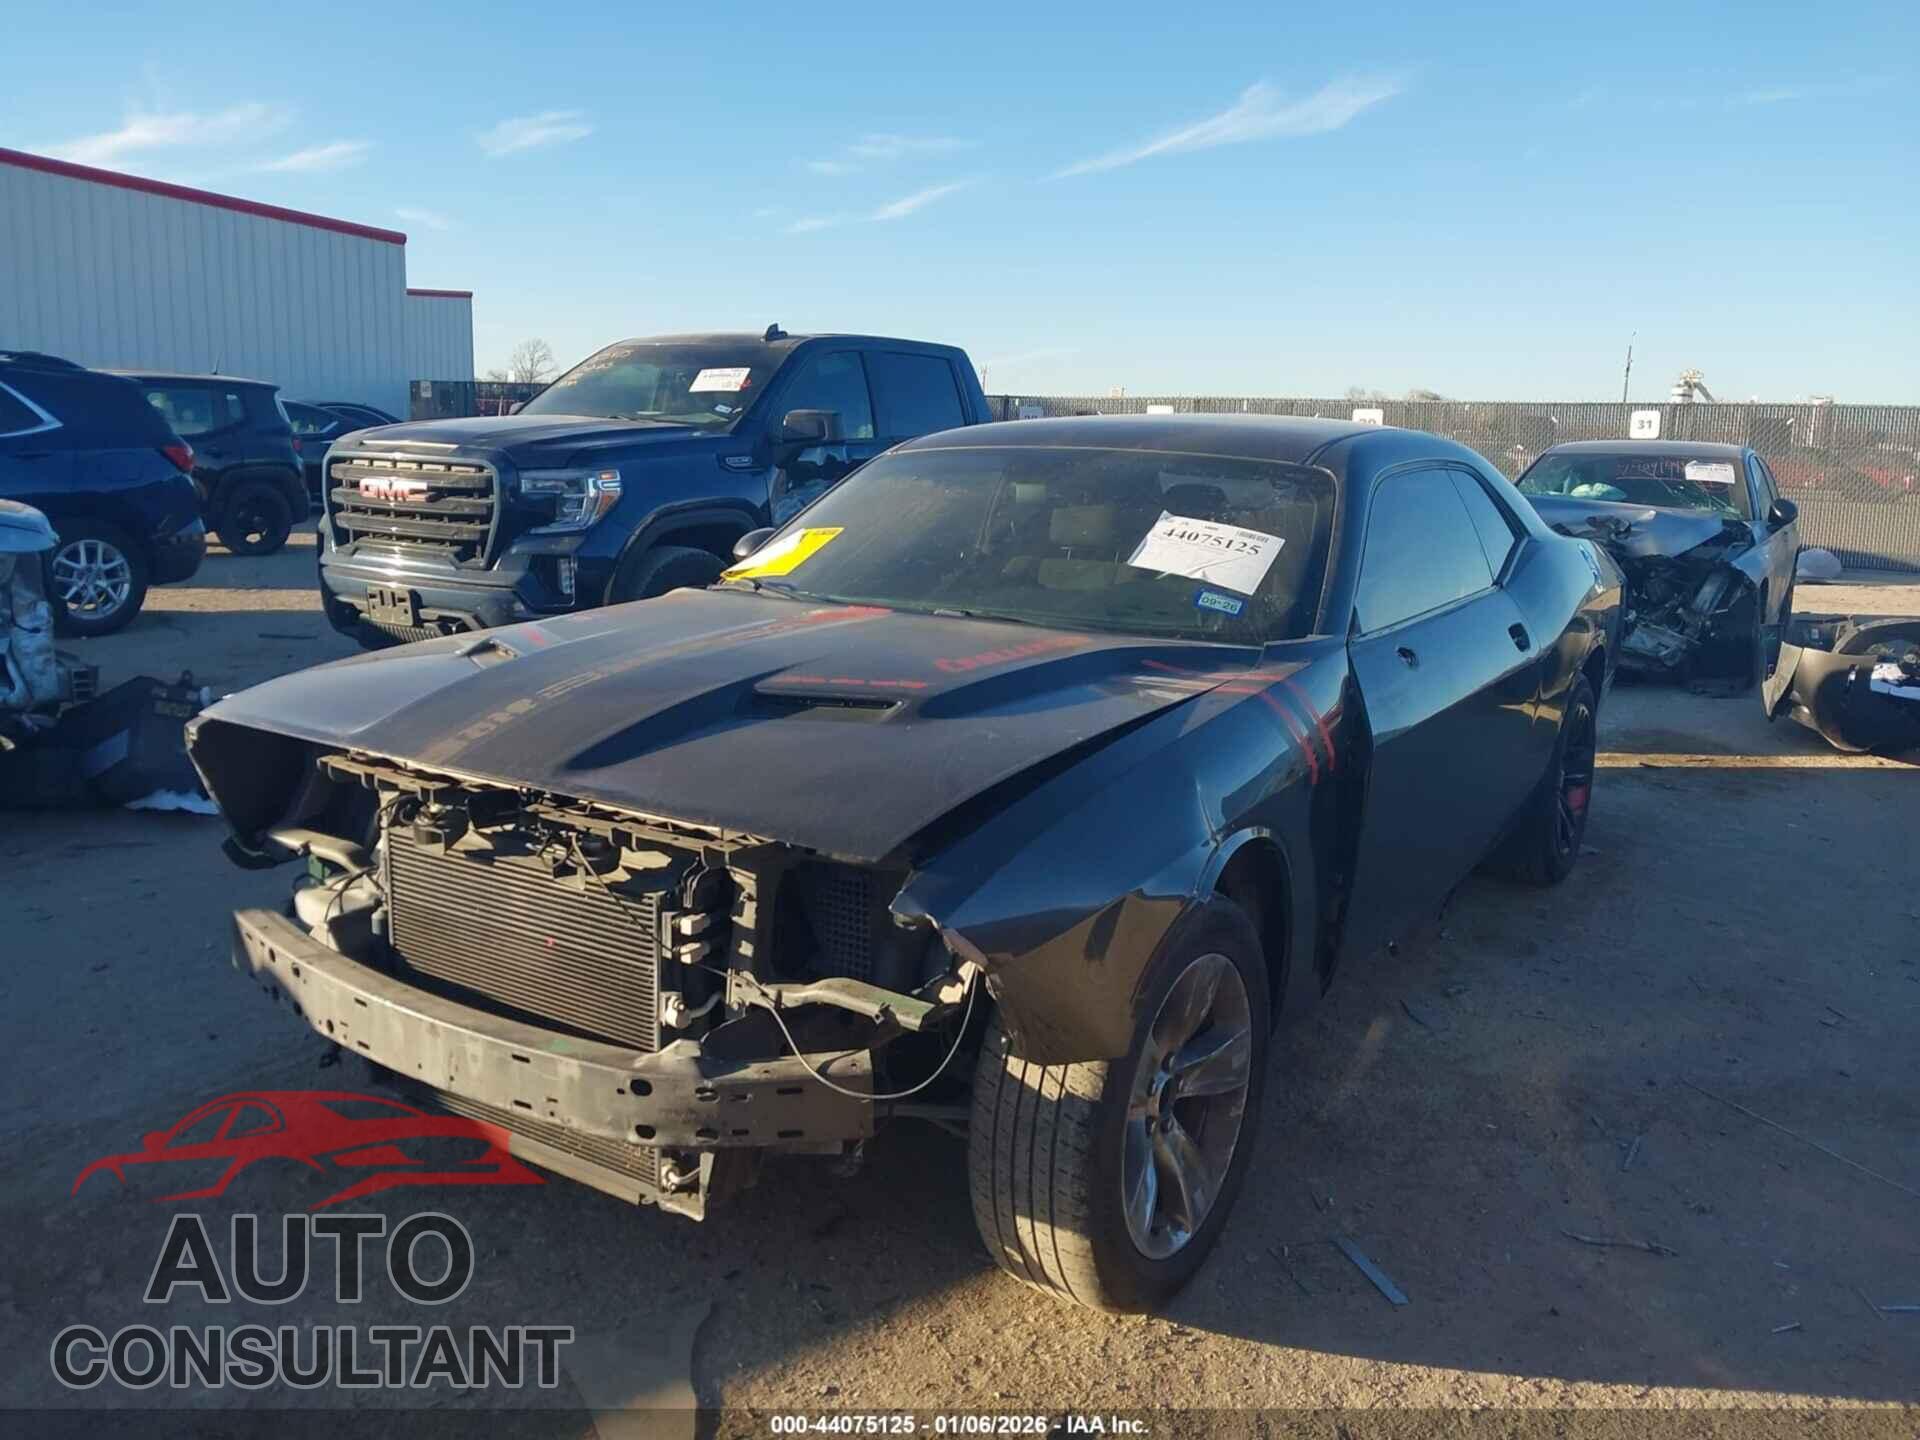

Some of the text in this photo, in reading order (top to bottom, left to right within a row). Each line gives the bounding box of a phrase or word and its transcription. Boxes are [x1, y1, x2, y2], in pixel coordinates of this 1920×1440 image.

[1636, 419, 1653, 430] 31
[359, 478, 428, 502] GMC
[1162, 526, 1263, 556] 44075125
